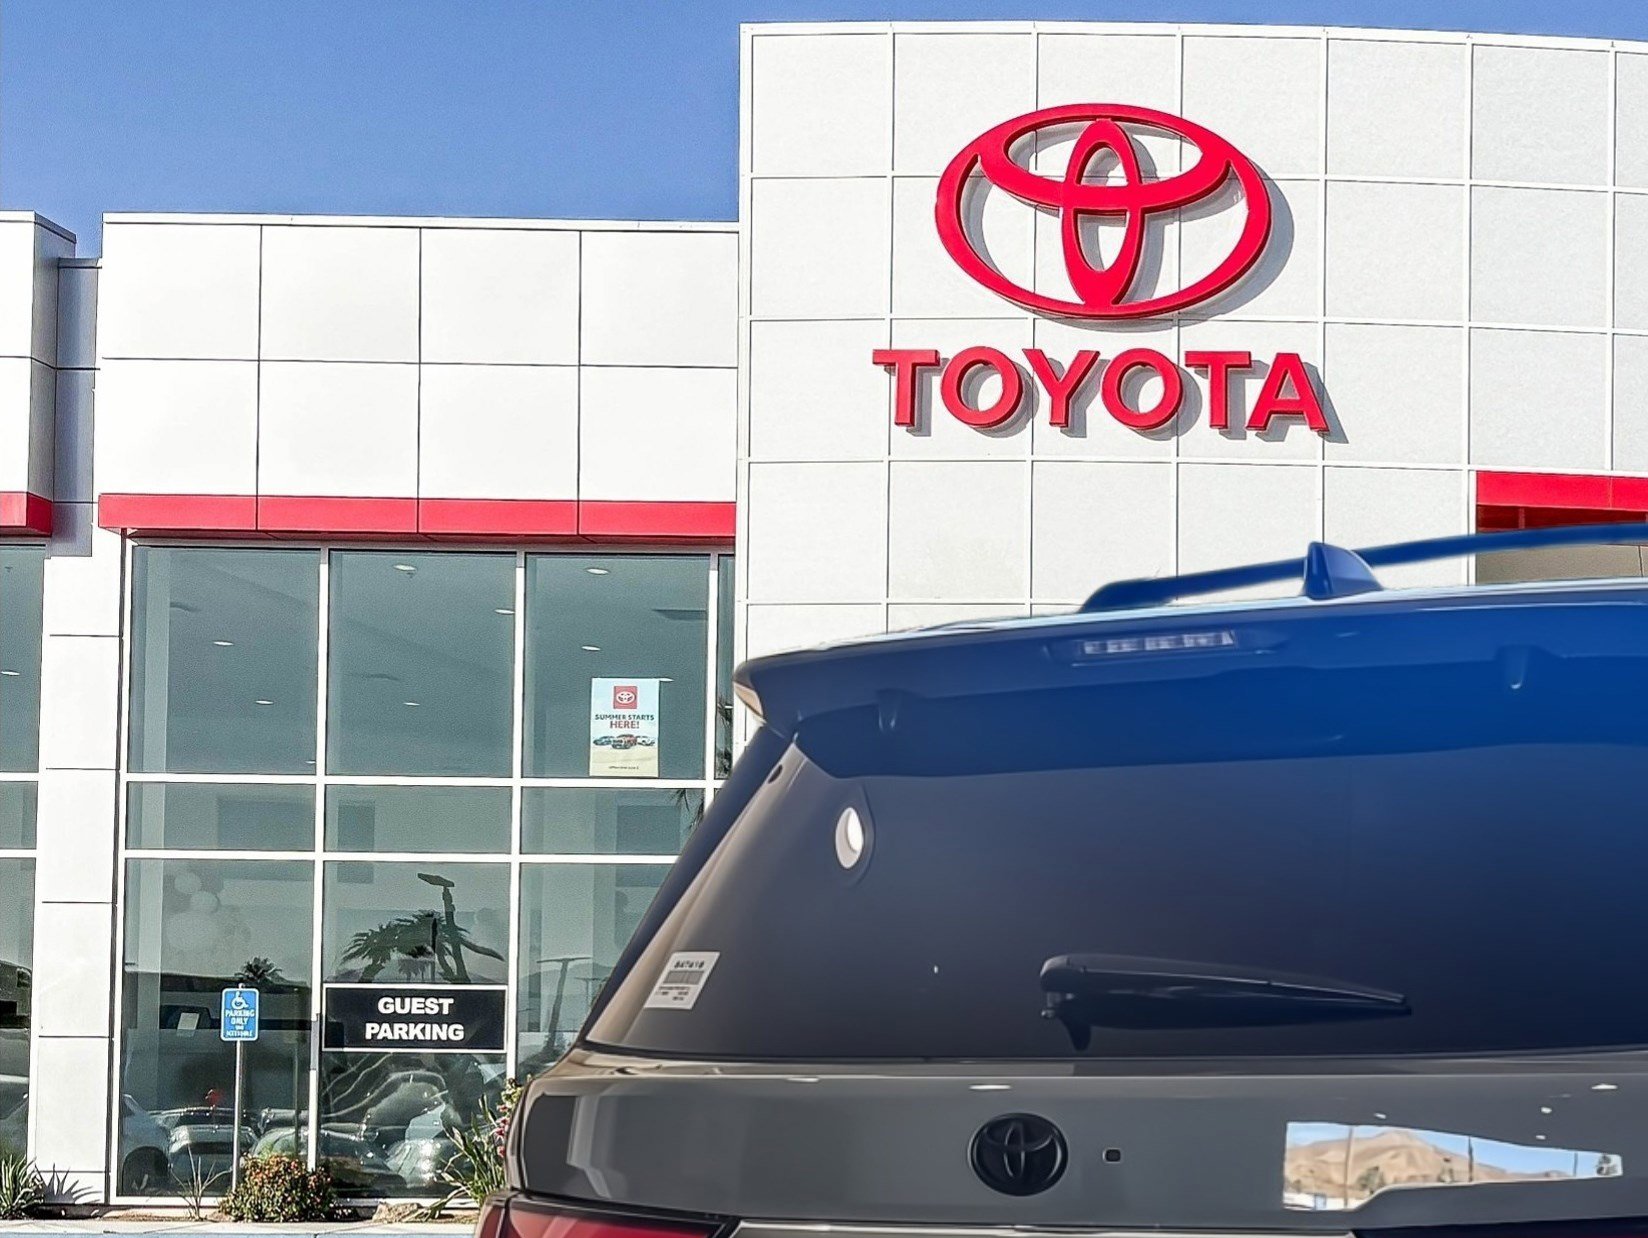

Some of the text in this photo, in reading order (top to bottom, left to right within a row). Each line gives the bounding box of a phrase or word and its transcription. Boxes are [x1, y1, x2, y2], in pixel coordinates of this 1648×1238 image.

[872, 346, 1330, 433] TOYOTA
[609, 720, 640, 729] HERE!
[225, 1009, 255, 1018] PARKING
[377, 997, 455, 1015] GUEST
[365, 1022, 465, 1042] PARKING
